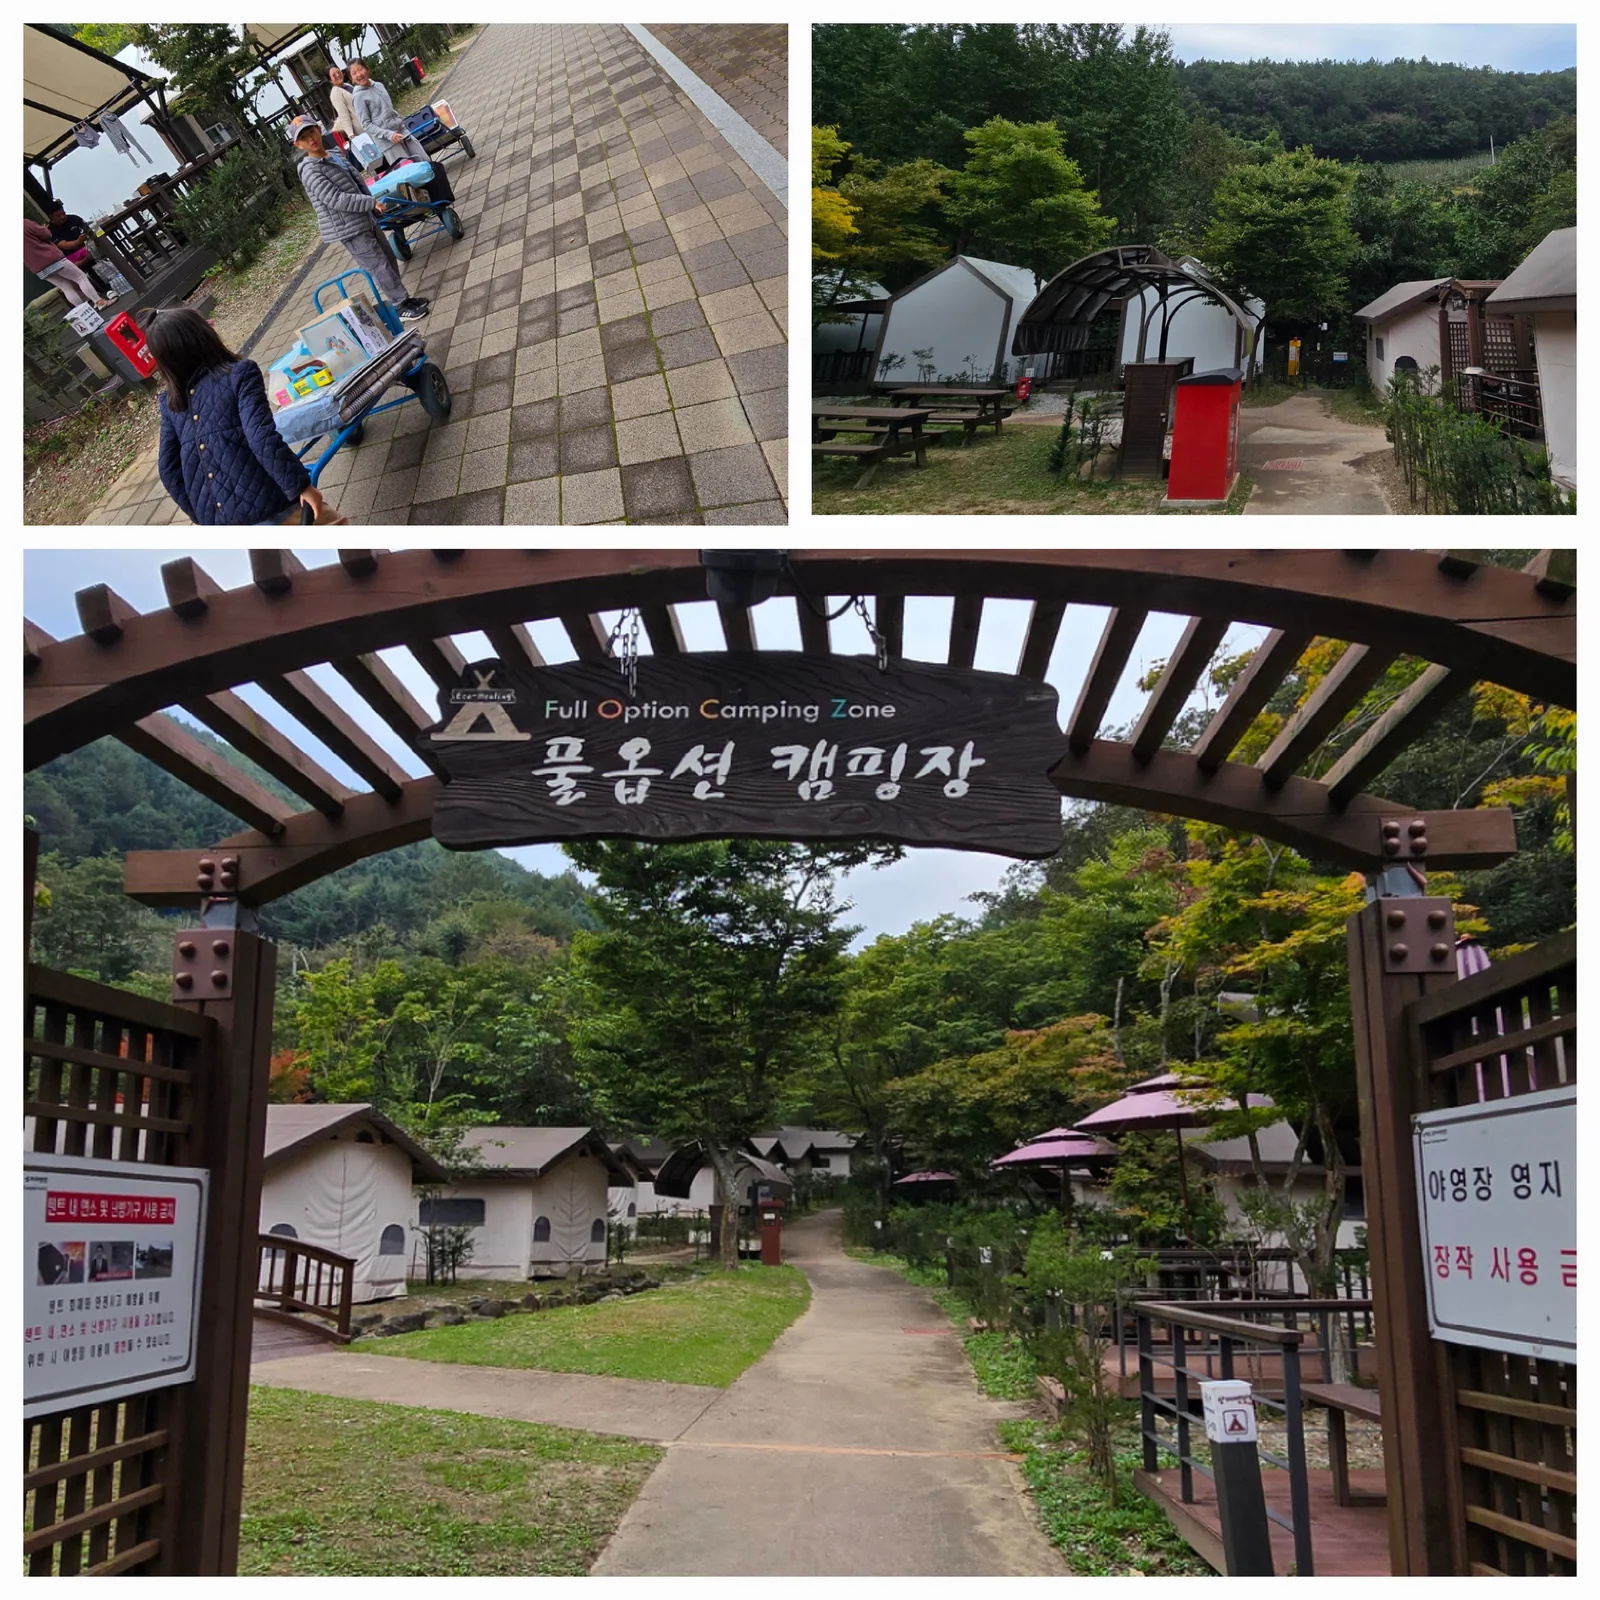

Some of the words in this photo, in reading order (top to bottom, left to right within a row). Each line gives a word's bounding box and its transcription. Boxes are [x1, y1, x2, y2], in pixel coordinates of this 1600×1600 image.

[455, 692, 512, 701] Eco-Healing
[544, 700, 588, 719] Full
[597, 699, 690, 723] Option
[699, 700, 820, 723] Camping
[830, 700, 896, 719] Zone
[532, 737, 735, 806] 풀옵션
[770, 738, 985, 801] 캠핑장
[1429, 1167, 1492, 1202] 야영장
[1510, 1160, 1562, 1200] 영지
[143, 1202, 158, 1219] 사용
[160, 1203, 174, 1219] 금지
[1434, 1245, 1473, 1280] 장작
[1490, 1247, 1539, 1286] 사용
